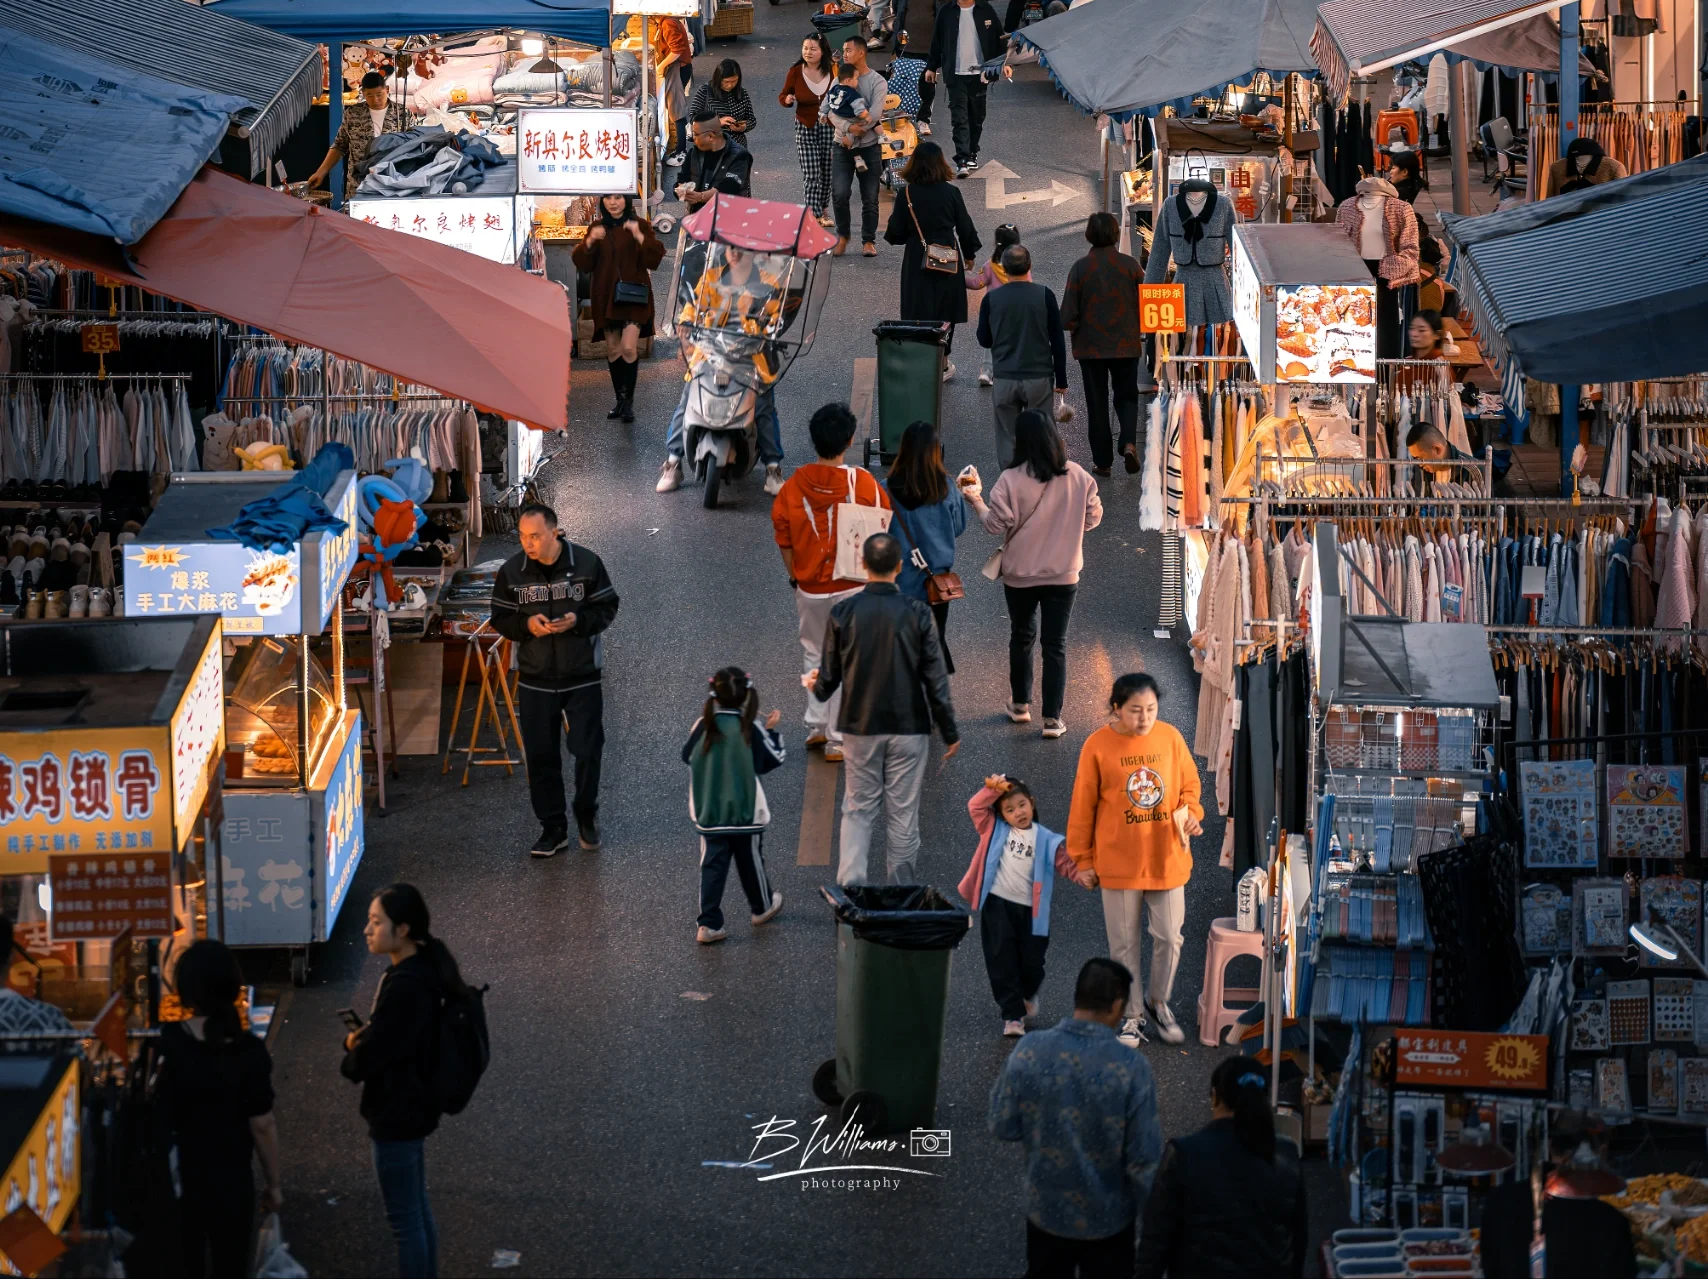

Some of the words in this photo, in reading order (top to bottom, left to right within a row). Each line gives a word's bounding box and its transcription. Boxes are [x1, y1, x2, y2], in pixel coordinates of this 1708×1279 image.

[523, 129, 631, 160] 新奥尔良烤翅
[1142, 288, 1182, 299] 限时秒杀
[170, 570, 211, 591] 爆浆
[135, 592, 239, 612] 手工大麻花
[1120, 755, 1145, 767] TIGER
[224, 817, 283, 843] 手工
